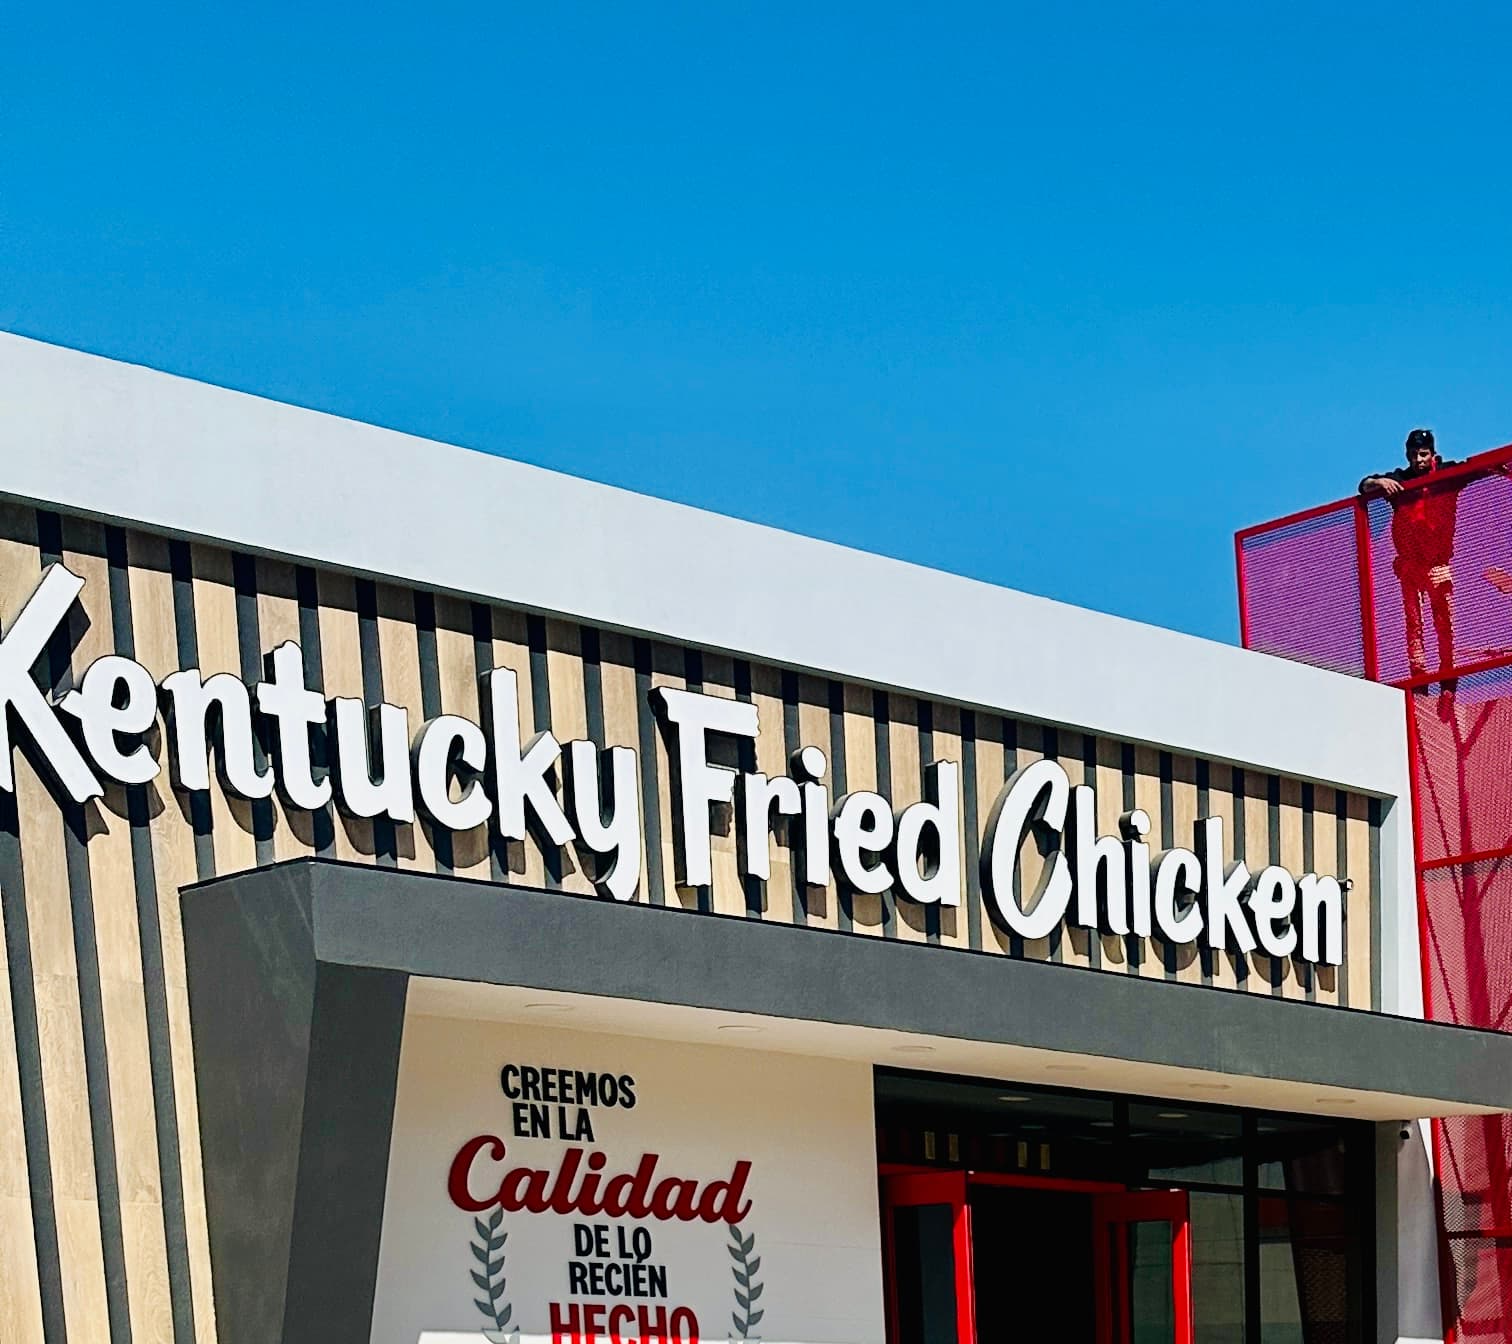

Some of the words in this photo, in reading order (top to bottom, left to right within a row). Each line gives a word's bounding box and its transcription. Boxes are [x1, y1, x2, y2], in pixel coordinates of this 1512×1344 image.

[0, 562, 640, 900] Kentucky
[655, 686, 962, 907] Fried
[986, 758, 1343, 967] Chicken
[501, 1063, 637, 1109] CREEMOS
[513, 1102, 551, 1139] EN
[558, 1105, 595, 1142] LA
[447, 1134, 753, 1225] Calidad
[574, 1223, 609, 1258] DE
[617, 1225, 652, 1260] LO
[568, 1259, 668, 1298] RECIÉN
